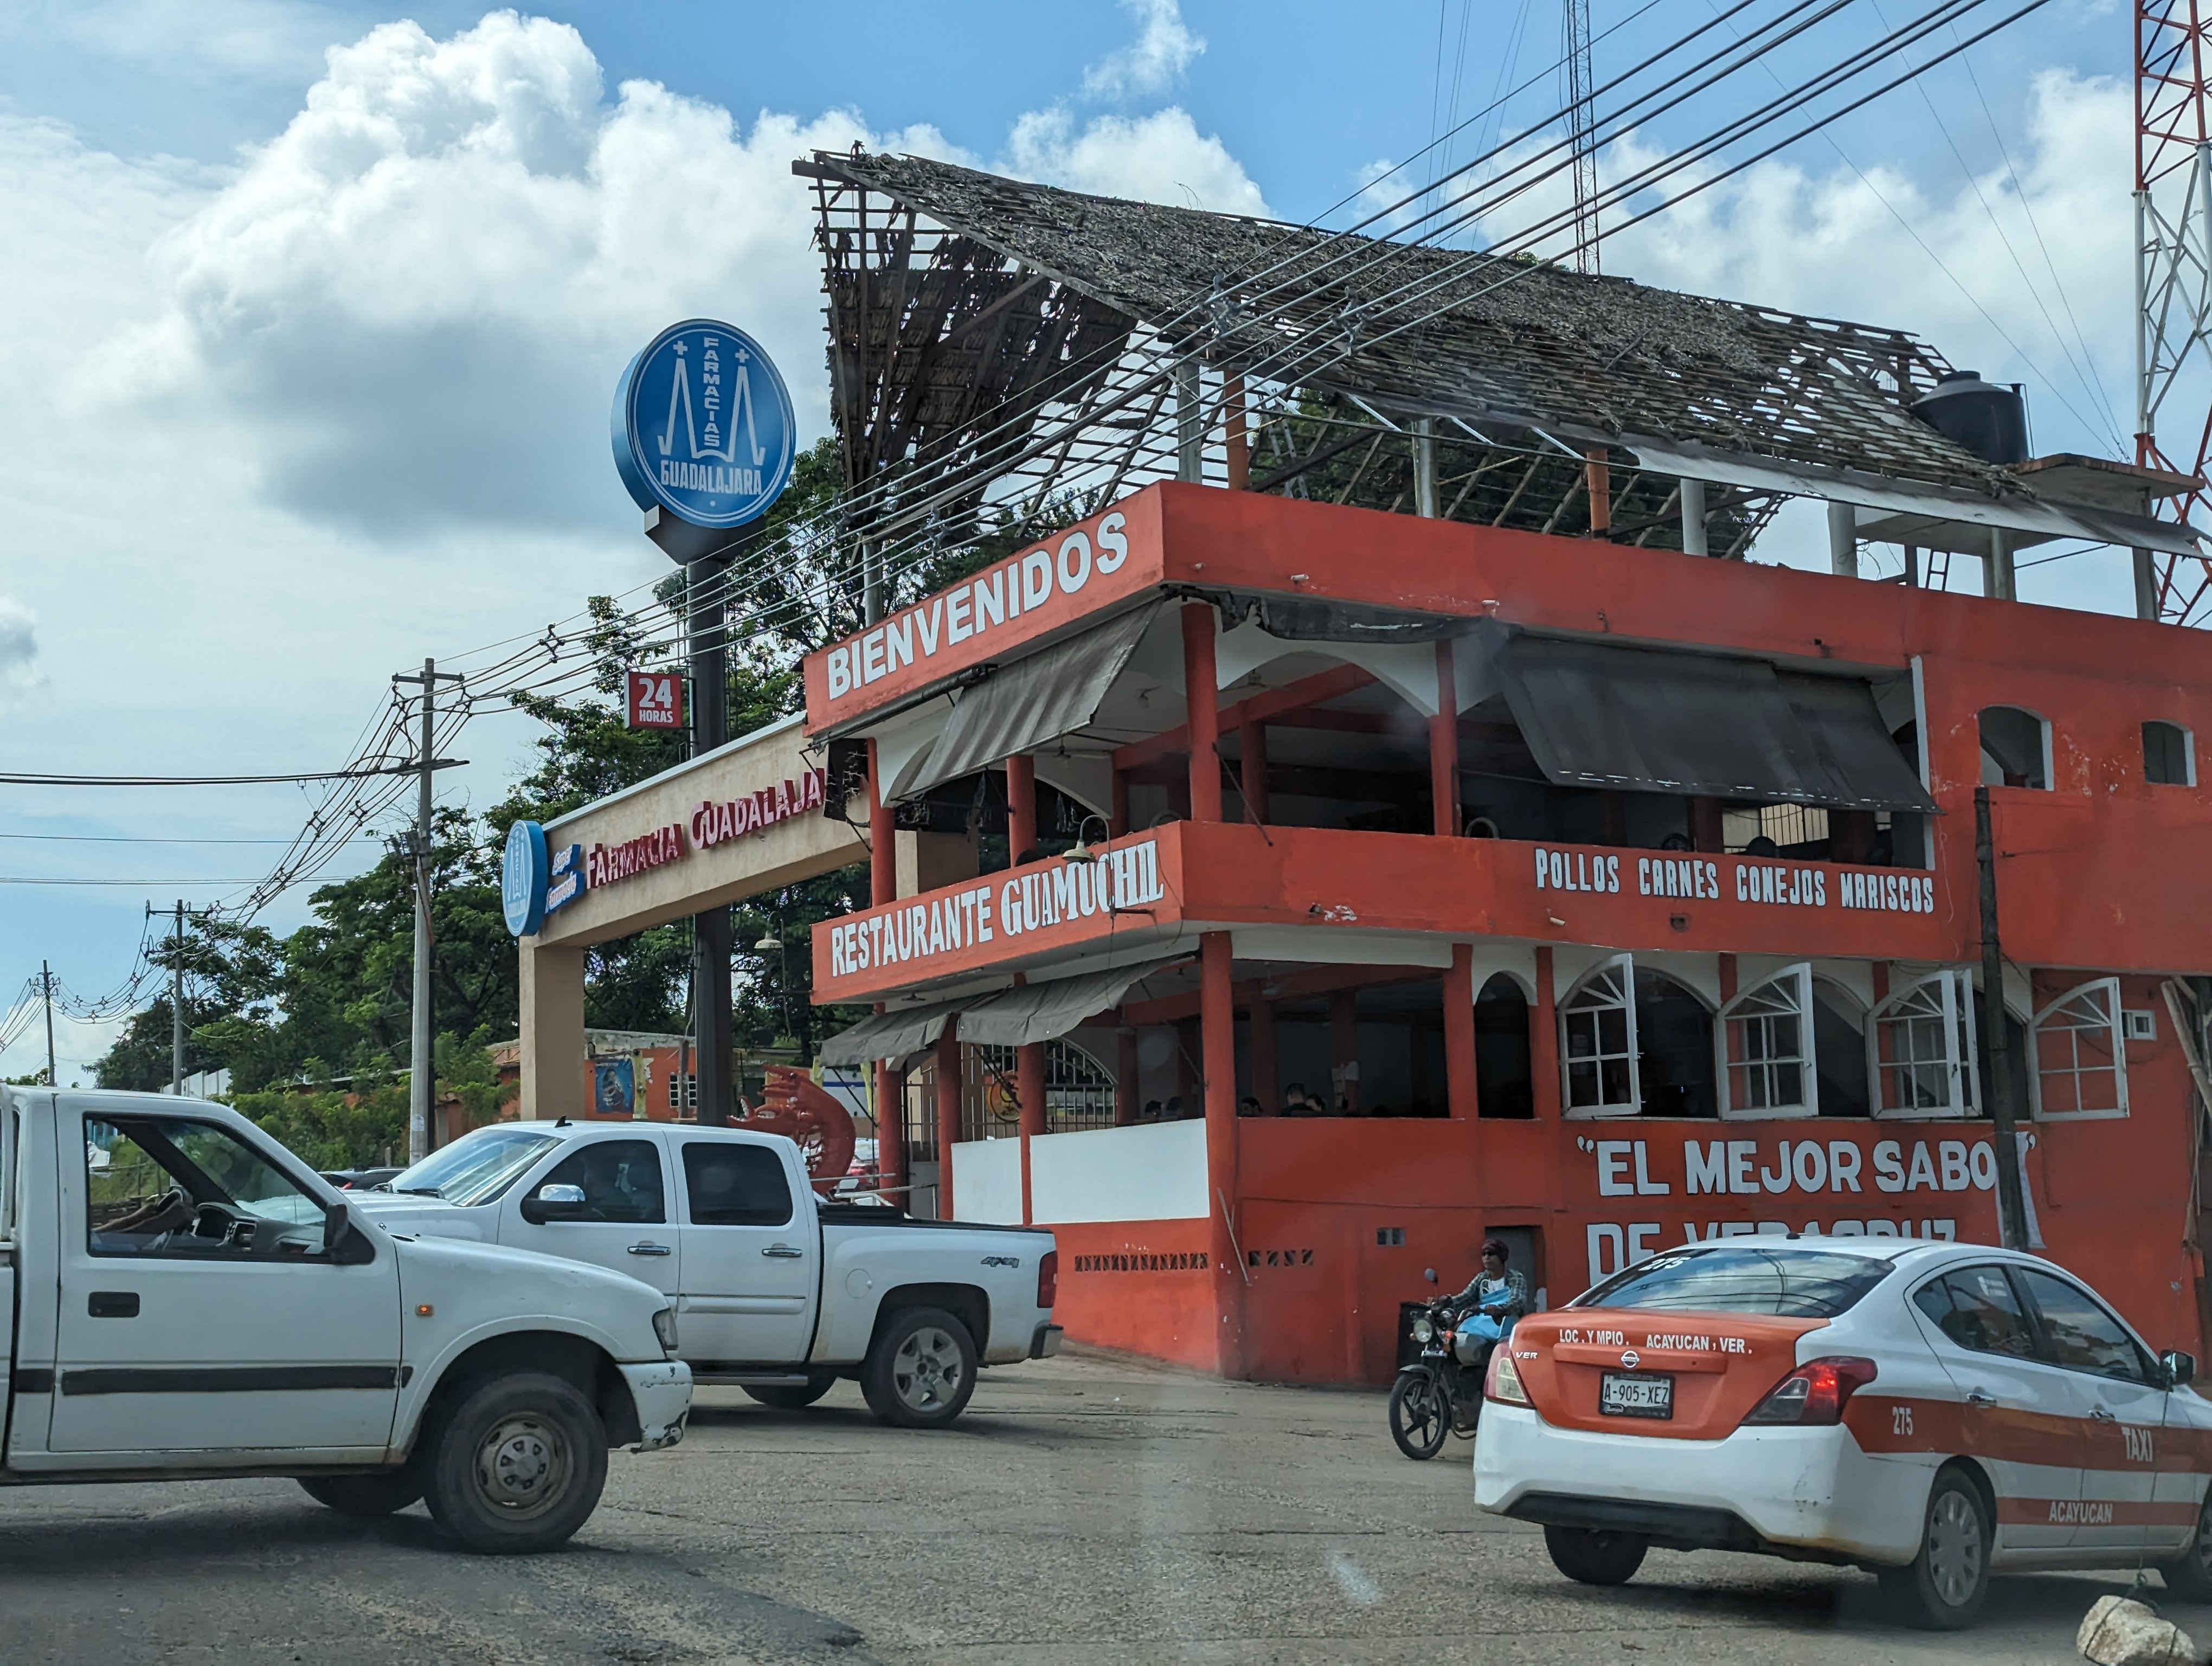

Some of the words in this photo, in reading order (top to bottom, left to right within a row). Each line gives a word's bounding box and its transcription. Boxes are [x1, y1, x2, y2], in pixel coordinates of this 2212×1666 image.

[703, 337, 720, 446] FARMACIAS
[660, 459, 762, 495] GUADALAJARA
[827, 511, 1128, 700] BIENVENIDOS
[639, 677, 673, 709] 24
[639, 709, 673, 723] HORAS
[586, 823, 682, 890] FARMACIA
[689, 767, 826, 850] GUADALAJA
[1535, 847, 1619, 894] POLLOS
[1638, 857, 1719, 899] CARNES
[1736, 864, 1826, 906] CONEJOS
[1840, 872, 1934, 913] MARISCOS
[831, 886, 993, 977] RESTAURANTE
[1000, 840, 1165, 937] GUAMUCHIL
[1685, 1139, 1862, 1194] MEJOR
[1637, 1256, 1692, 1272] 275
[1586, 1330, 1594, 1343] Y
[1516, 1351, 1538, 1360] VER
[1604, 1383, 1669, 1405] A-905-XEZ
[1892, 1406, 1913, 1436] 275
[2122, 1426, 2153, 1463] TAXI
[2049, 1501, 2113, 1524] ACAYUCAN
